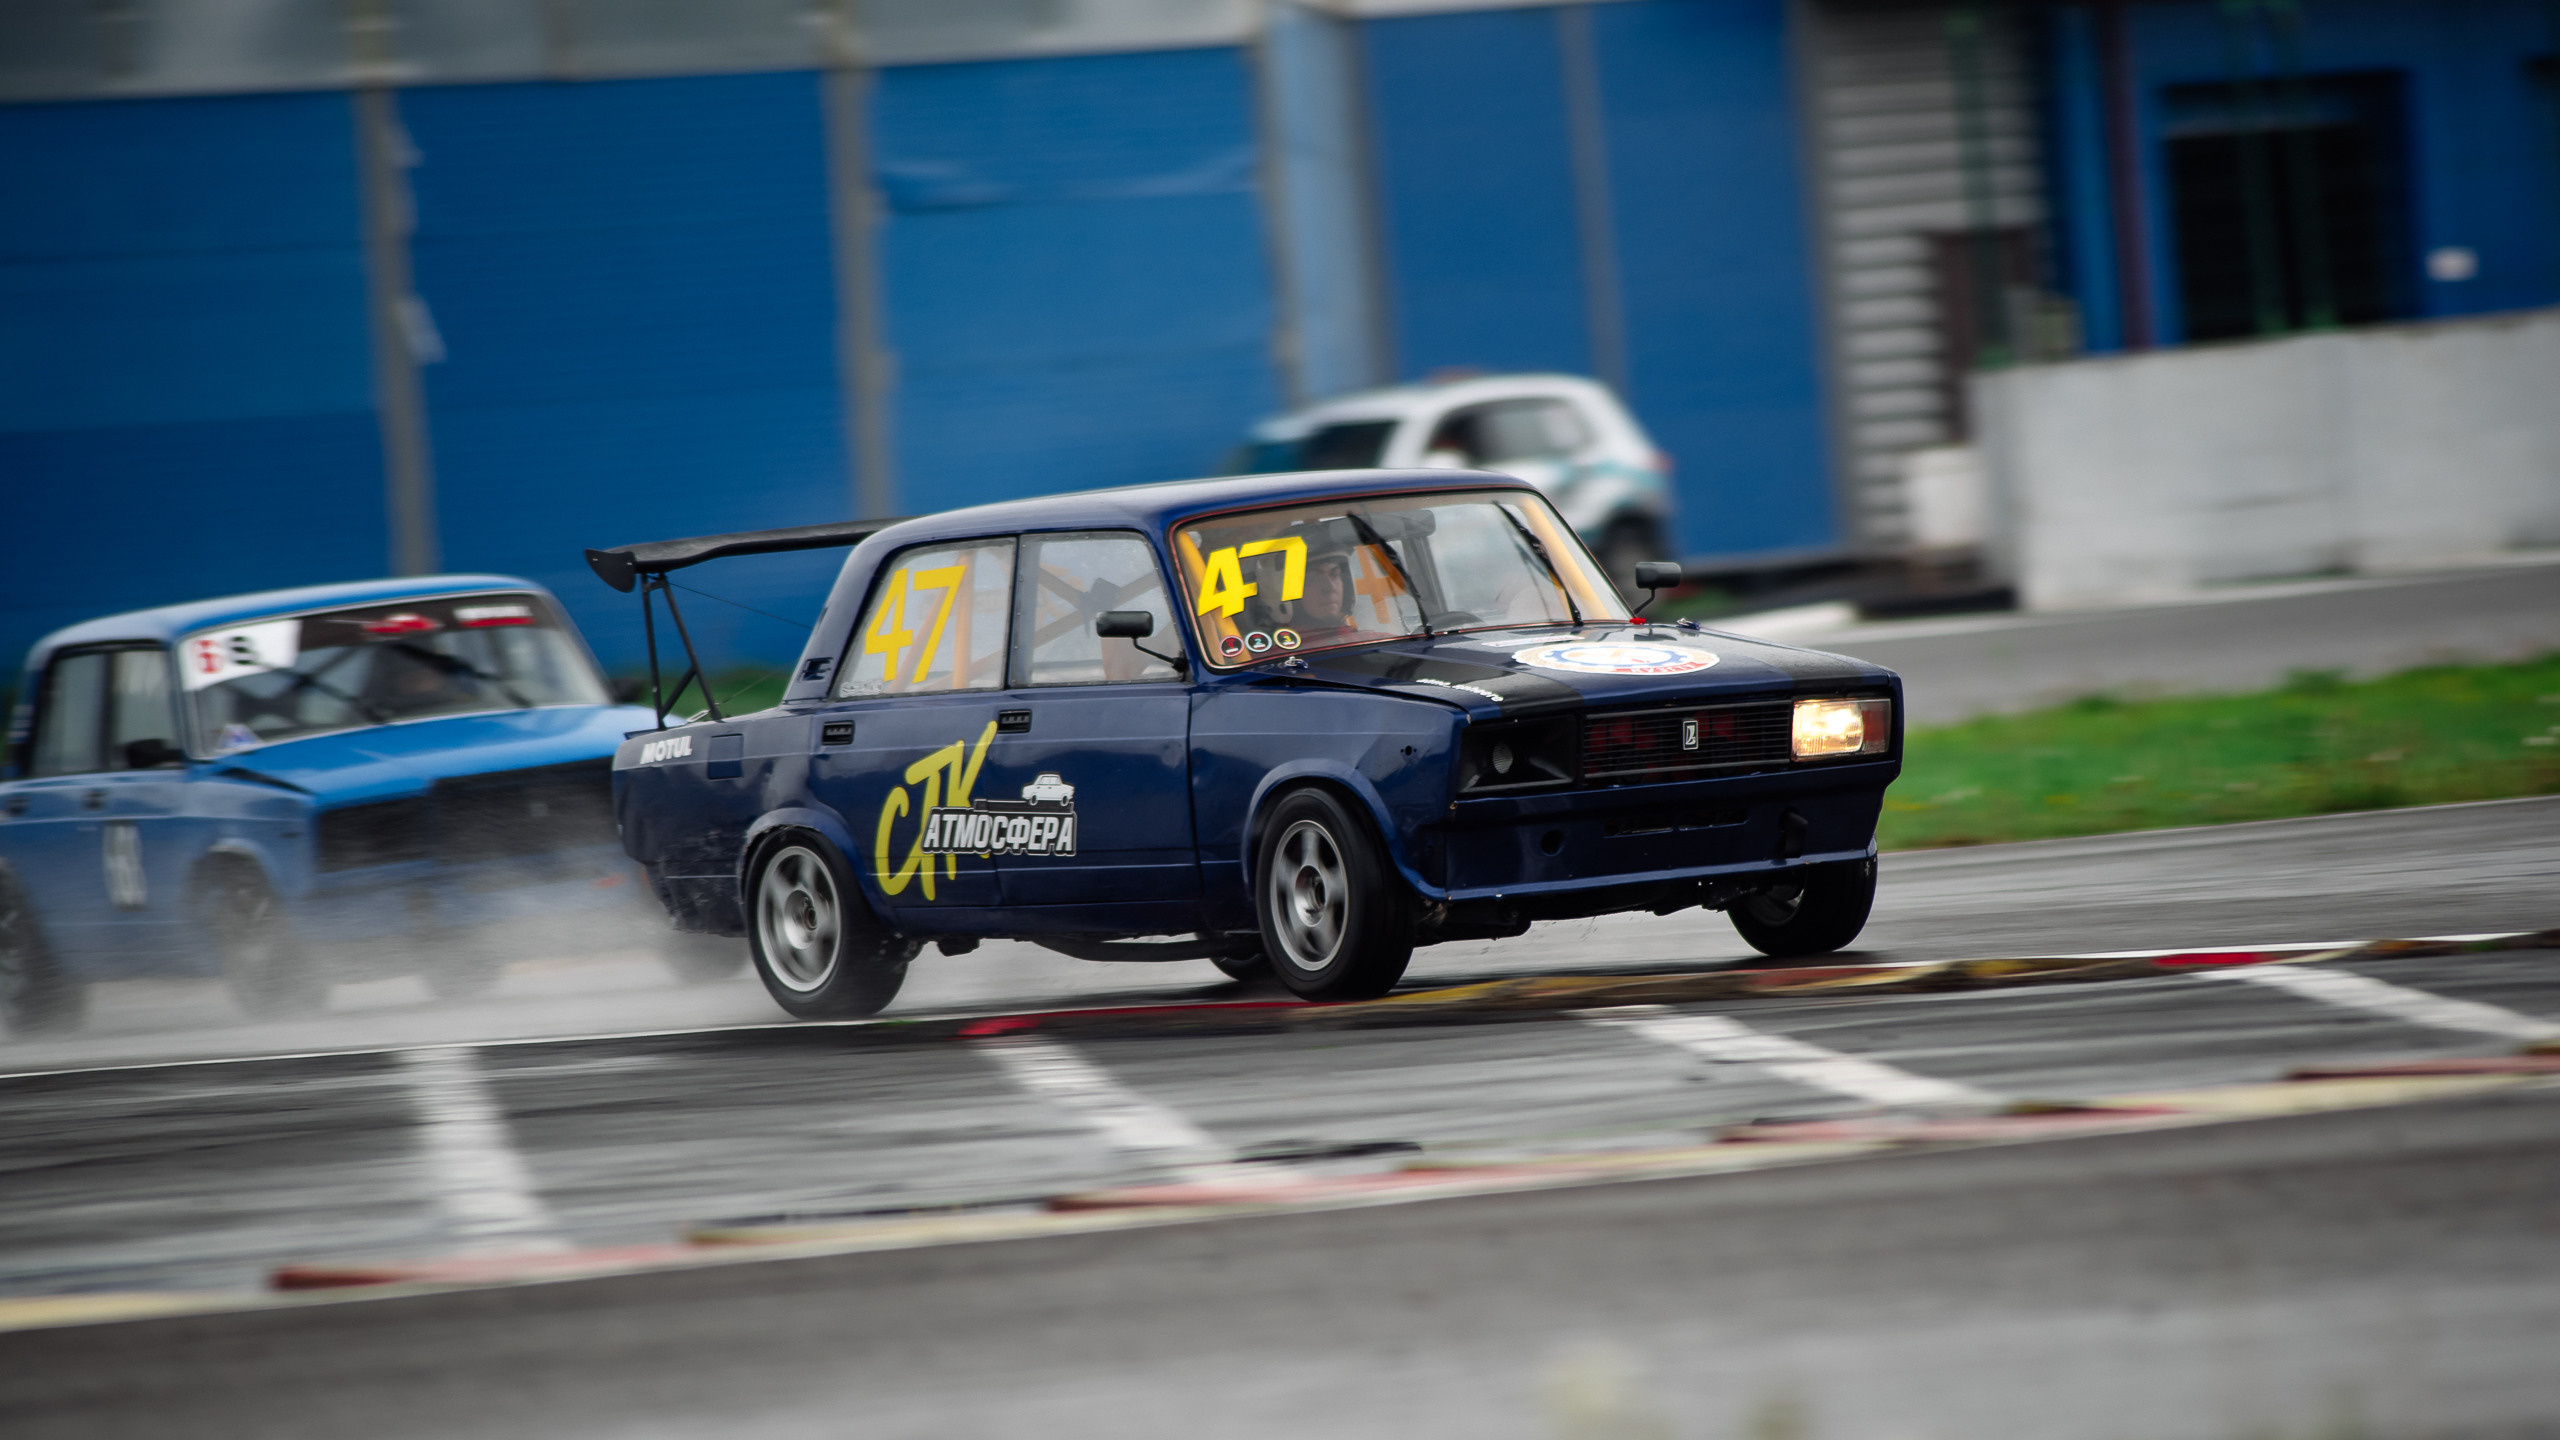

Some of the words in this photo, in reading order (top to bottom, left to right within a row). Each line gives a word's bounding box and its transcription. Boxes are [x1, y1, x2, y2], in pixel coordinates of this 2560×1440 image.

[1197, 536, 1308, 619] 47
[864, 565, 967, 684] 47
[640, 735, 693, 765] MOTUL
[923, 813, 1074, 852] АТМОСФЕРА
